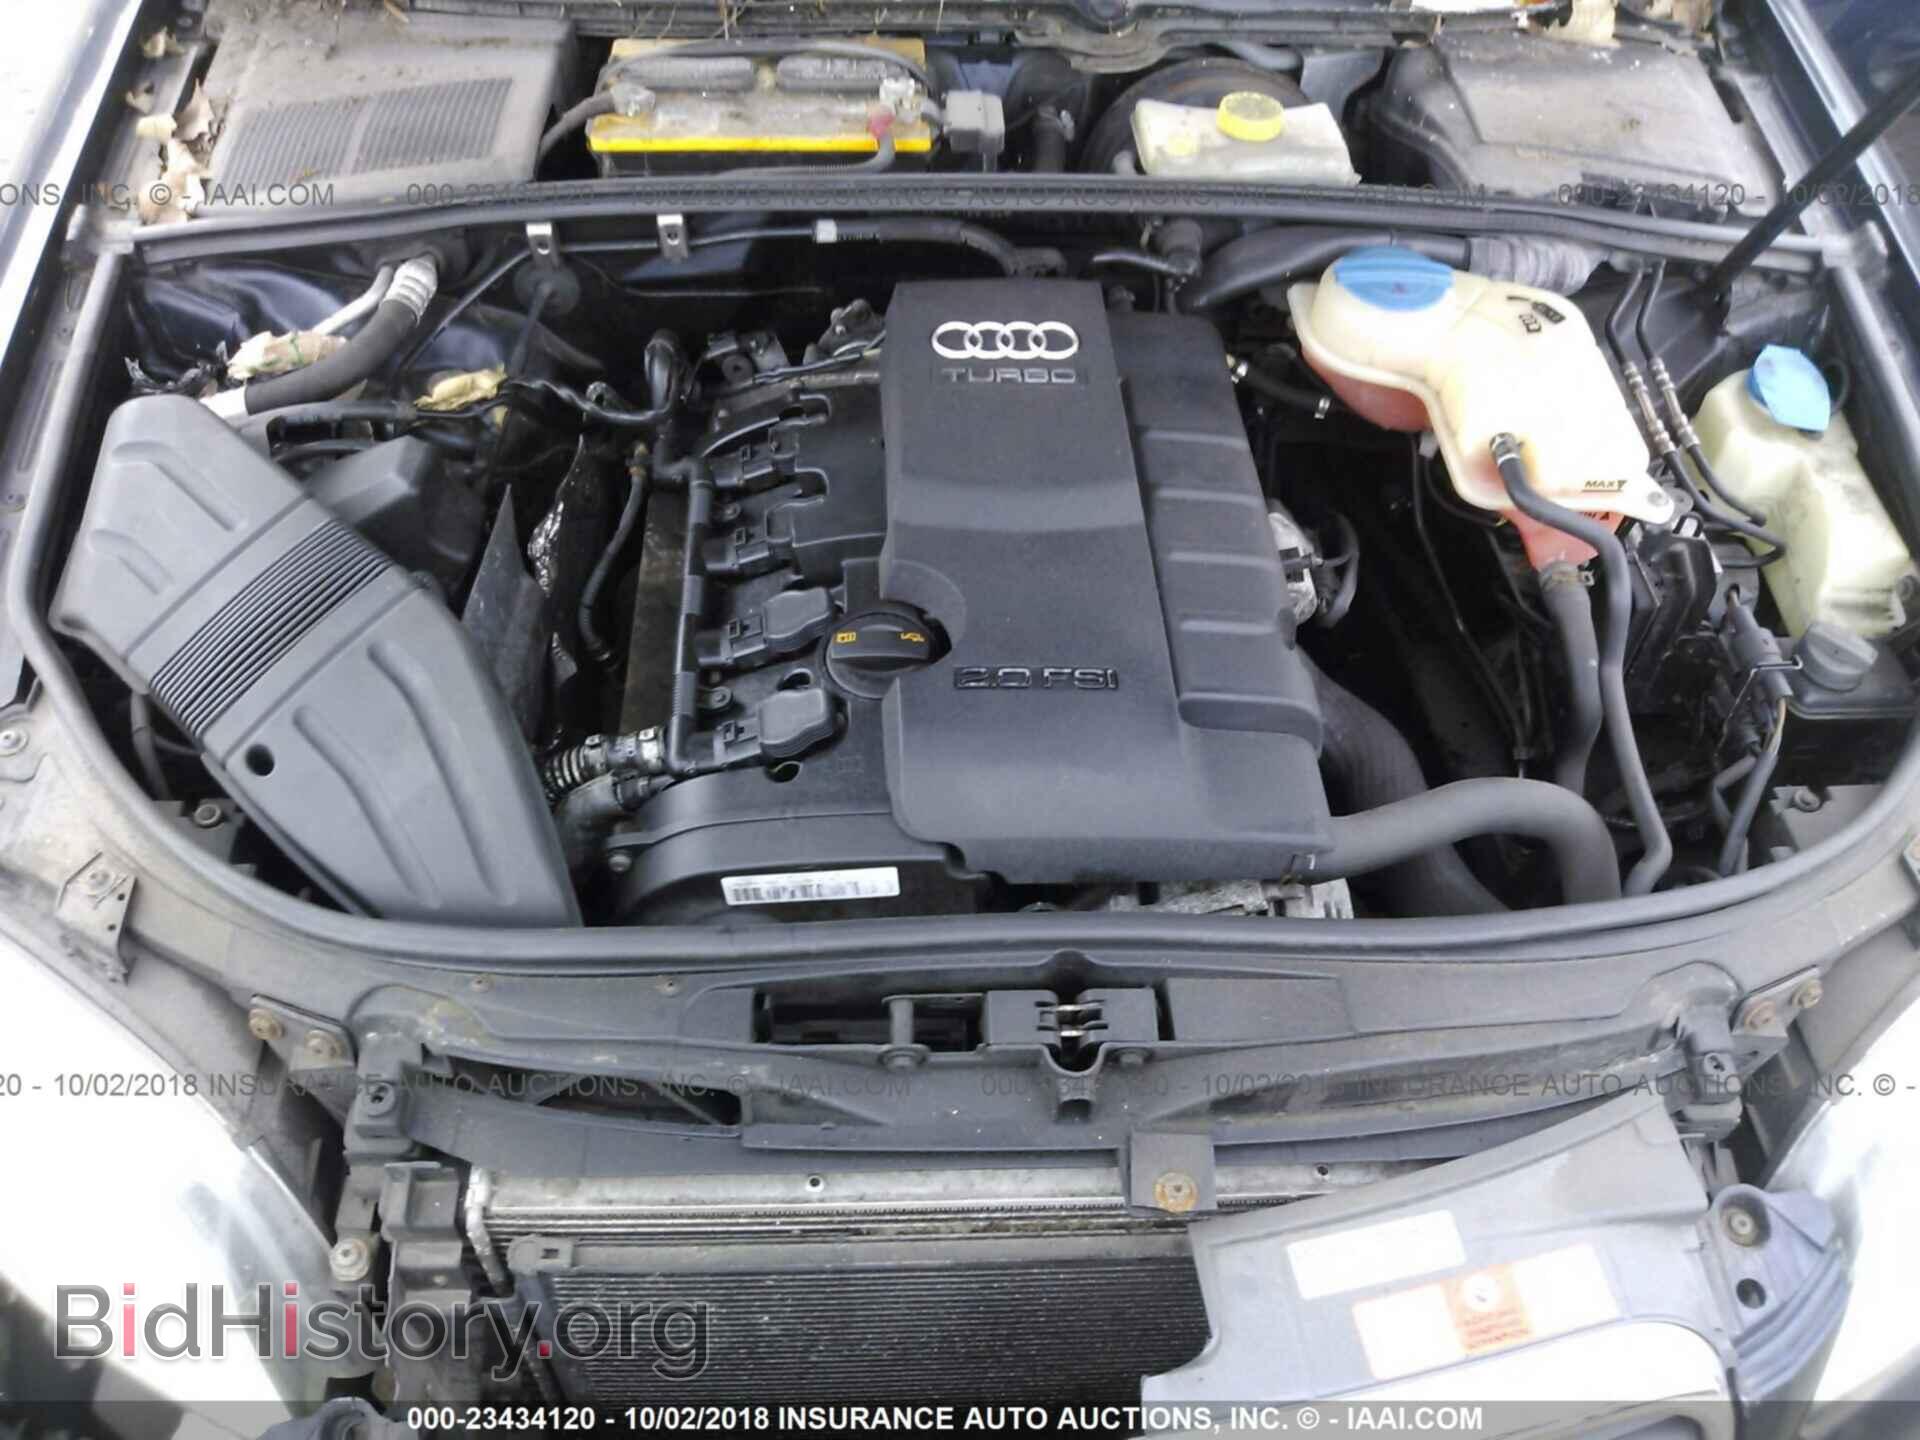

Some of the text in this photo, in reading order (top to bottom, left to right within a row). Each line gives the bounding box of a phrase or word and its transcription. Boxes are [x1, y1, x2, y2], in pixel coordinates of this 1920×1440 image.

[939, 368, 1077, 384] TURBO
[1584, 480, 1616, 488] MAX
[957, 667, 1118, 689] 2.0 FSI
